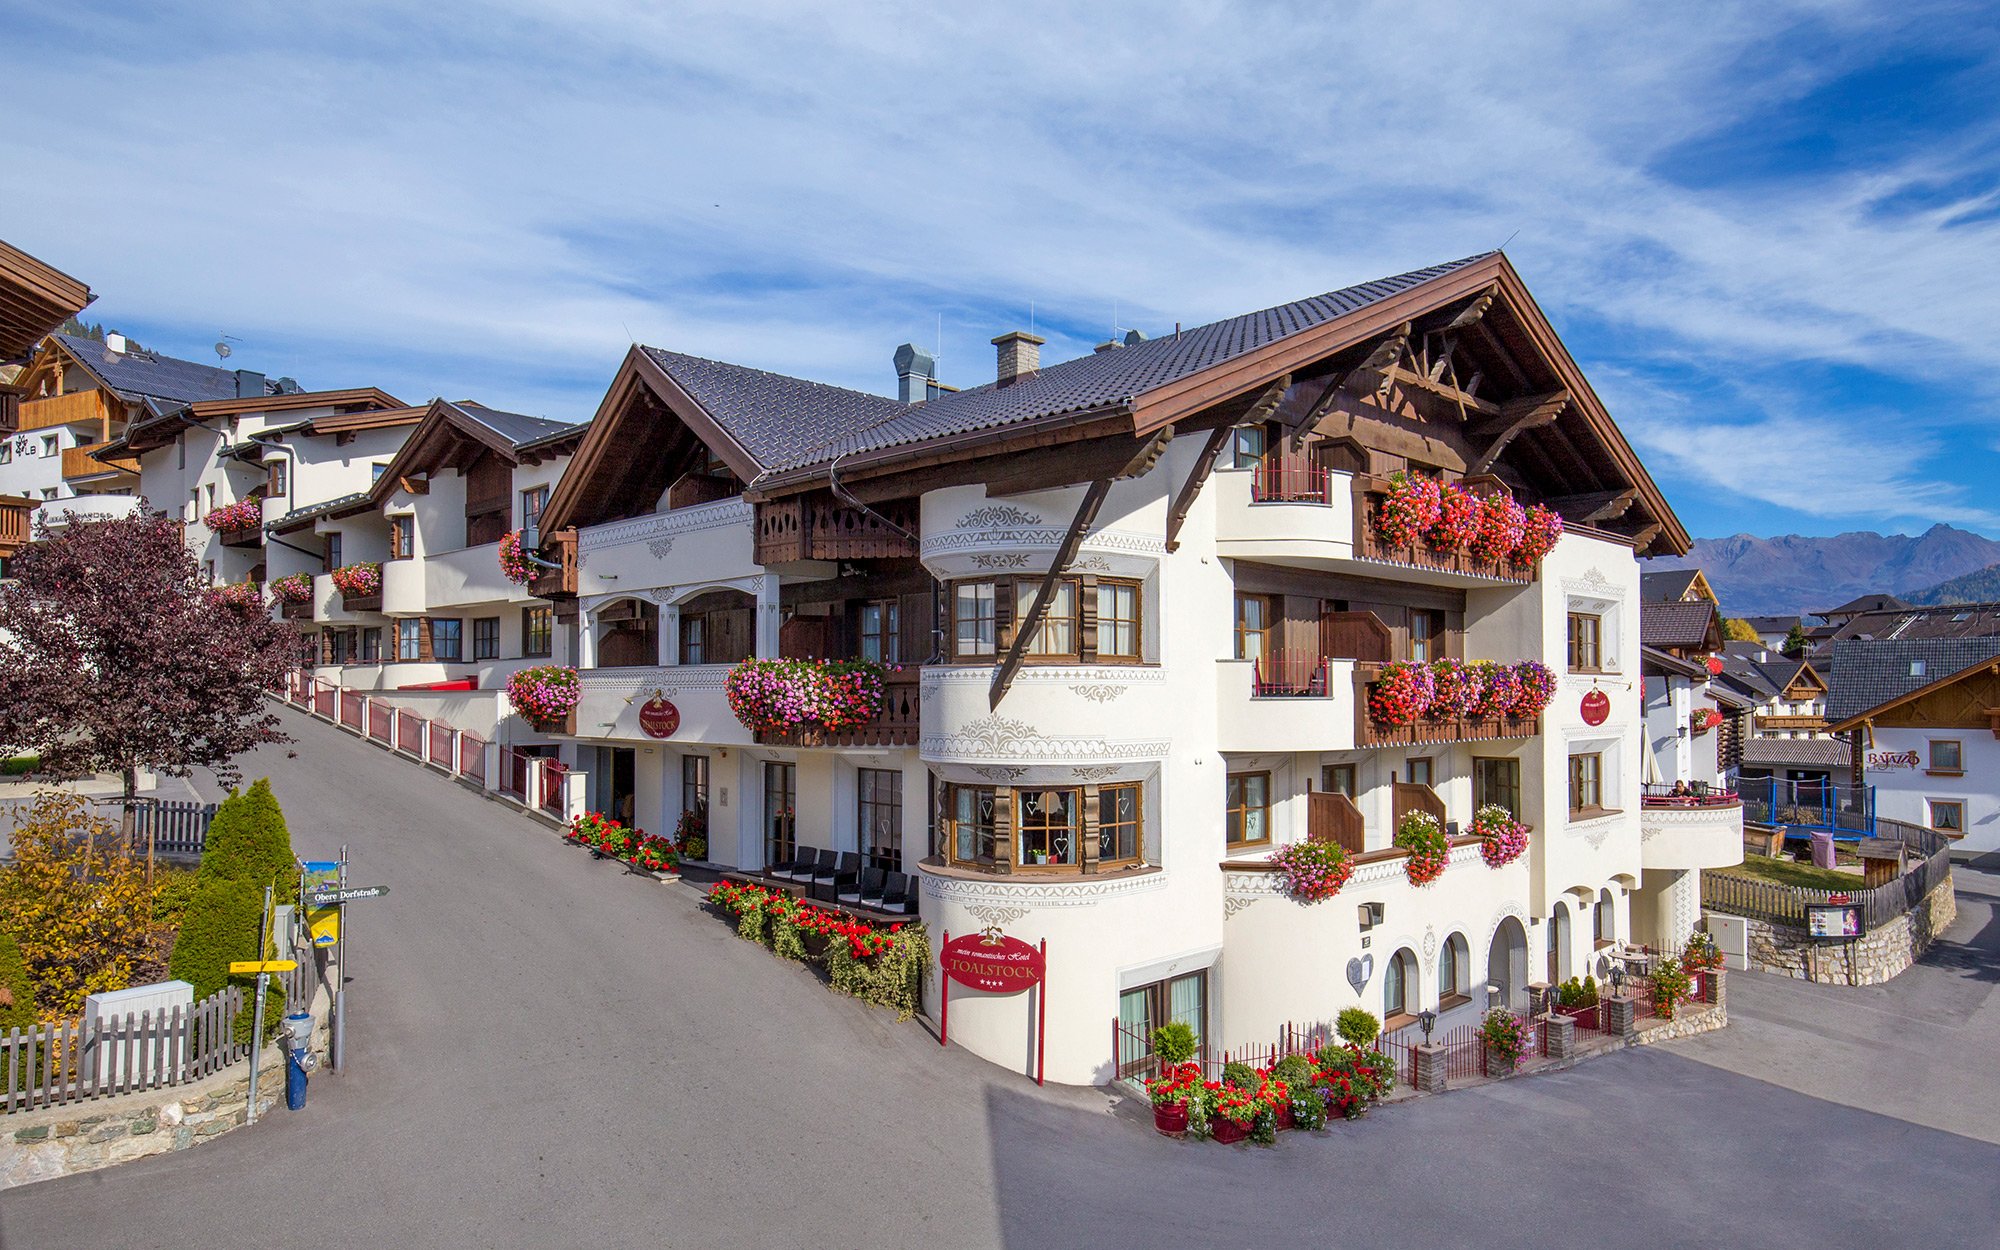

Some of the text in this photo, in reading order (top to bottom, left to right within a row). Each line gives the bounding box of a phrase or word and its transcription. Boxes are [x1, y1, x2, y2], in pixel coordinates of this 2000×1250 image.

[25, 445, 36, 455] LB
[314, 887, 380, 901] Obere Dorfstraße
[1007, 951, 1031, 961] Hotel
[950, 958, 1036, 979] TOALSTOCK
